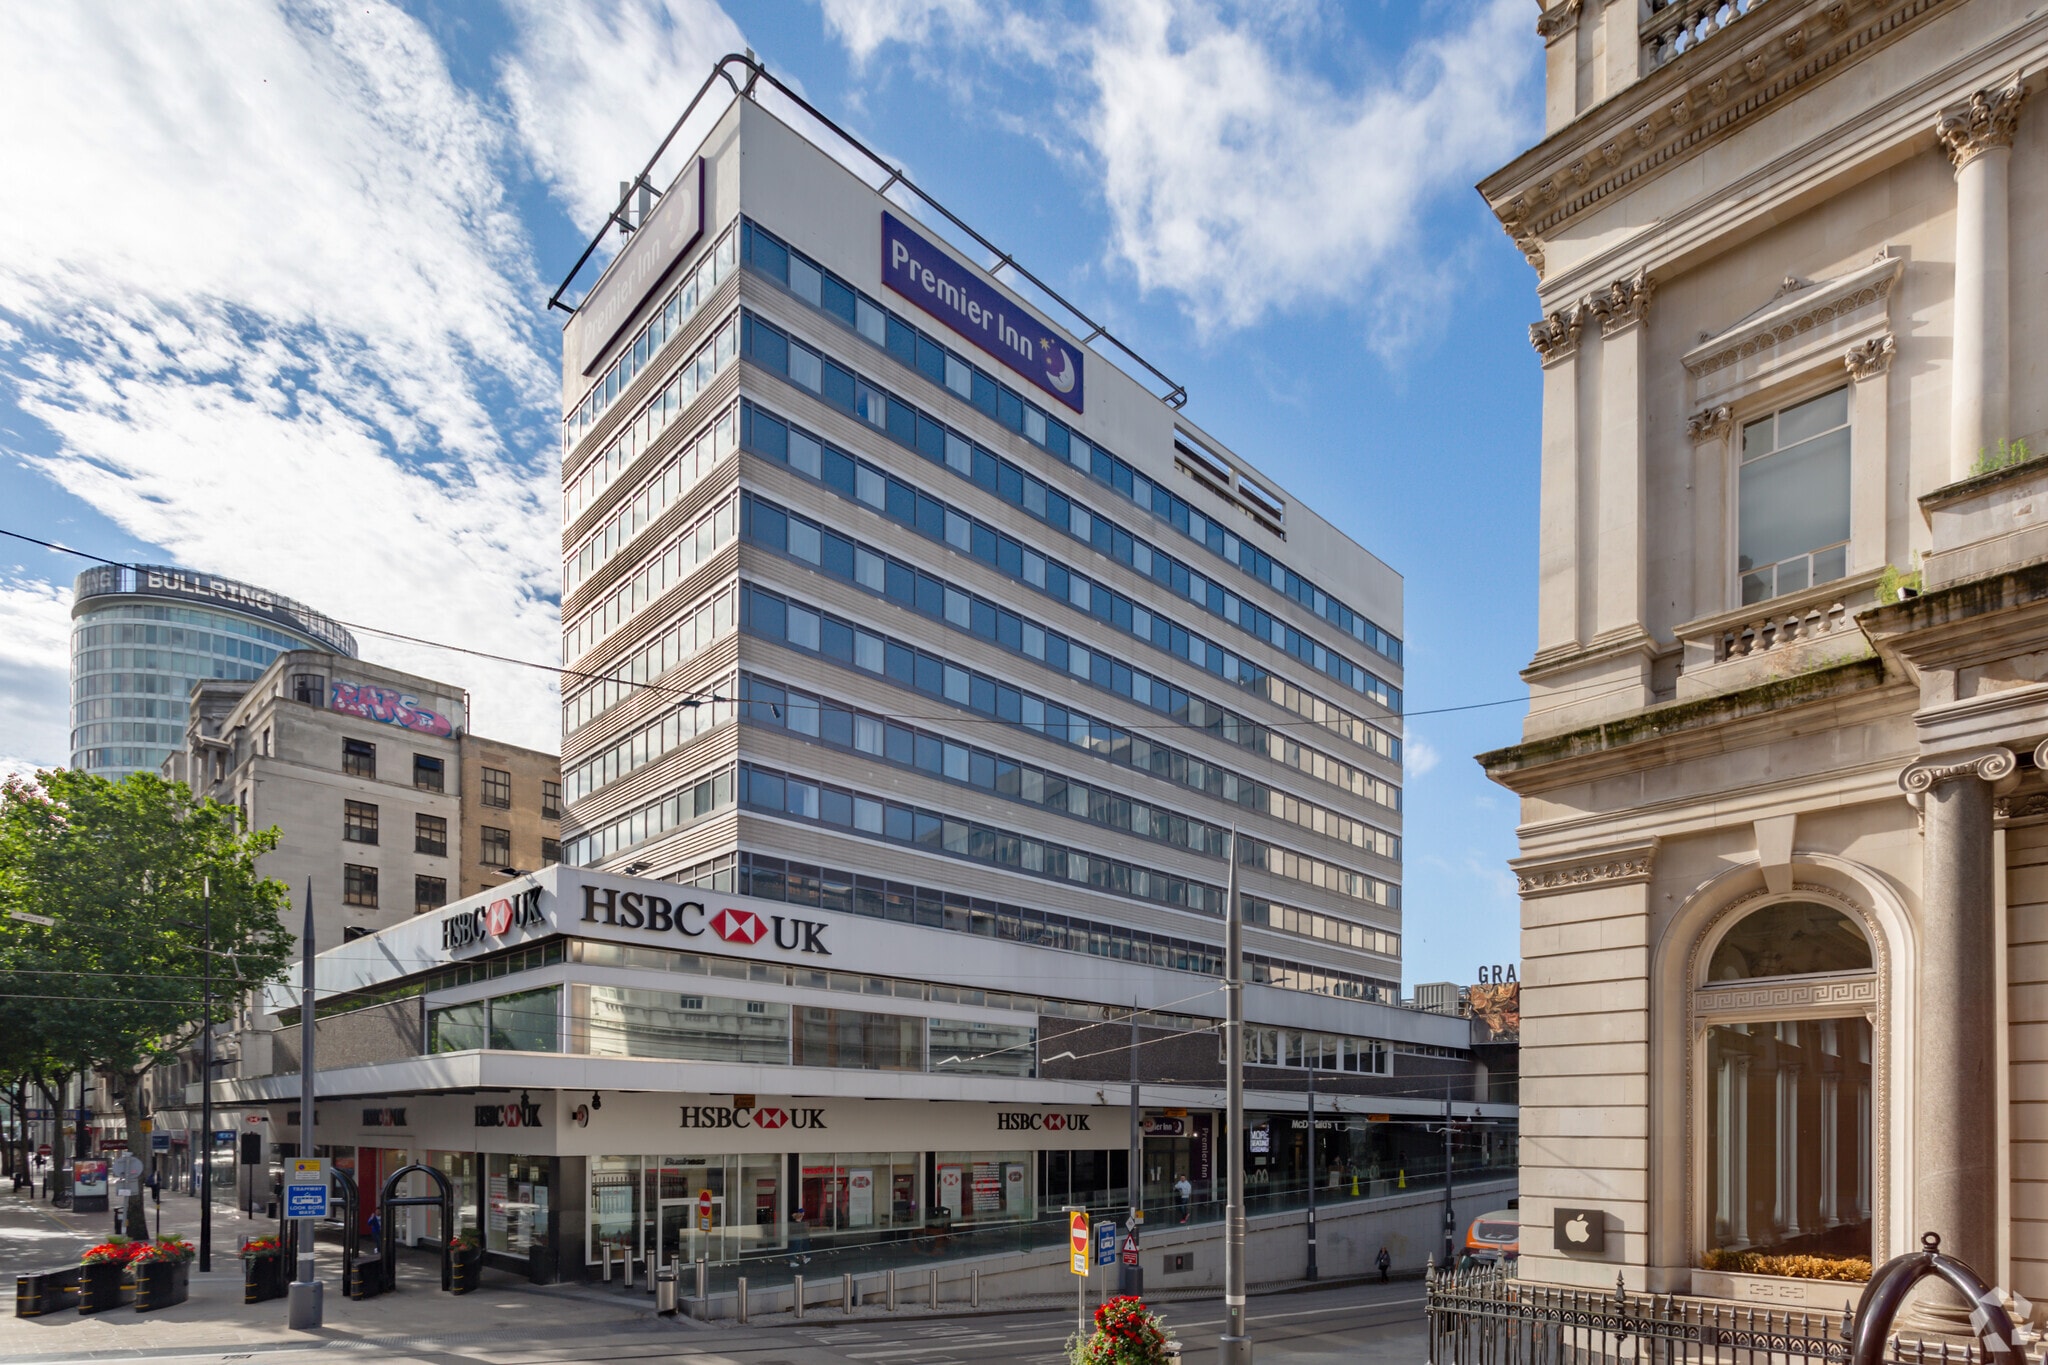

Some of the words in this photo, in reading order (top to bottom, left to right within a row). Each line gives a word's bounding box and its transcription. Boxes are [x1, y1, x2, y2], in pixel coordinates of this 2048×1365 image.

[584, 269, 635, 344] Premier
[638, 238, 661, 283] Inn
[892, 239, 993, 331] Premier
[998, 313, 1033, 361] Inn
[148, 571, 273, 613] BULLRING
[441, 906, 486, 951] HSBC
[512, 886, 545, 929] UK
[581, 885, 705, 937] HSBC
[771, 915, 832, 955] UK
[1478, 964, 1517, 984] GRA
[474, 1105, 505, 1127] HSBC
[521, 1104, 542, 1127] UK
[680, 1106, 751, 1129] HSBC
[789, 1108, 827, 1129] UK
[997, 1112, 1042, 1131] HSBC
[1066, 1114, 1091, 1131] UK
[1201, 1127, 1209, 1163] Premier
[1201, 1164, 1209, 1178] Inn
